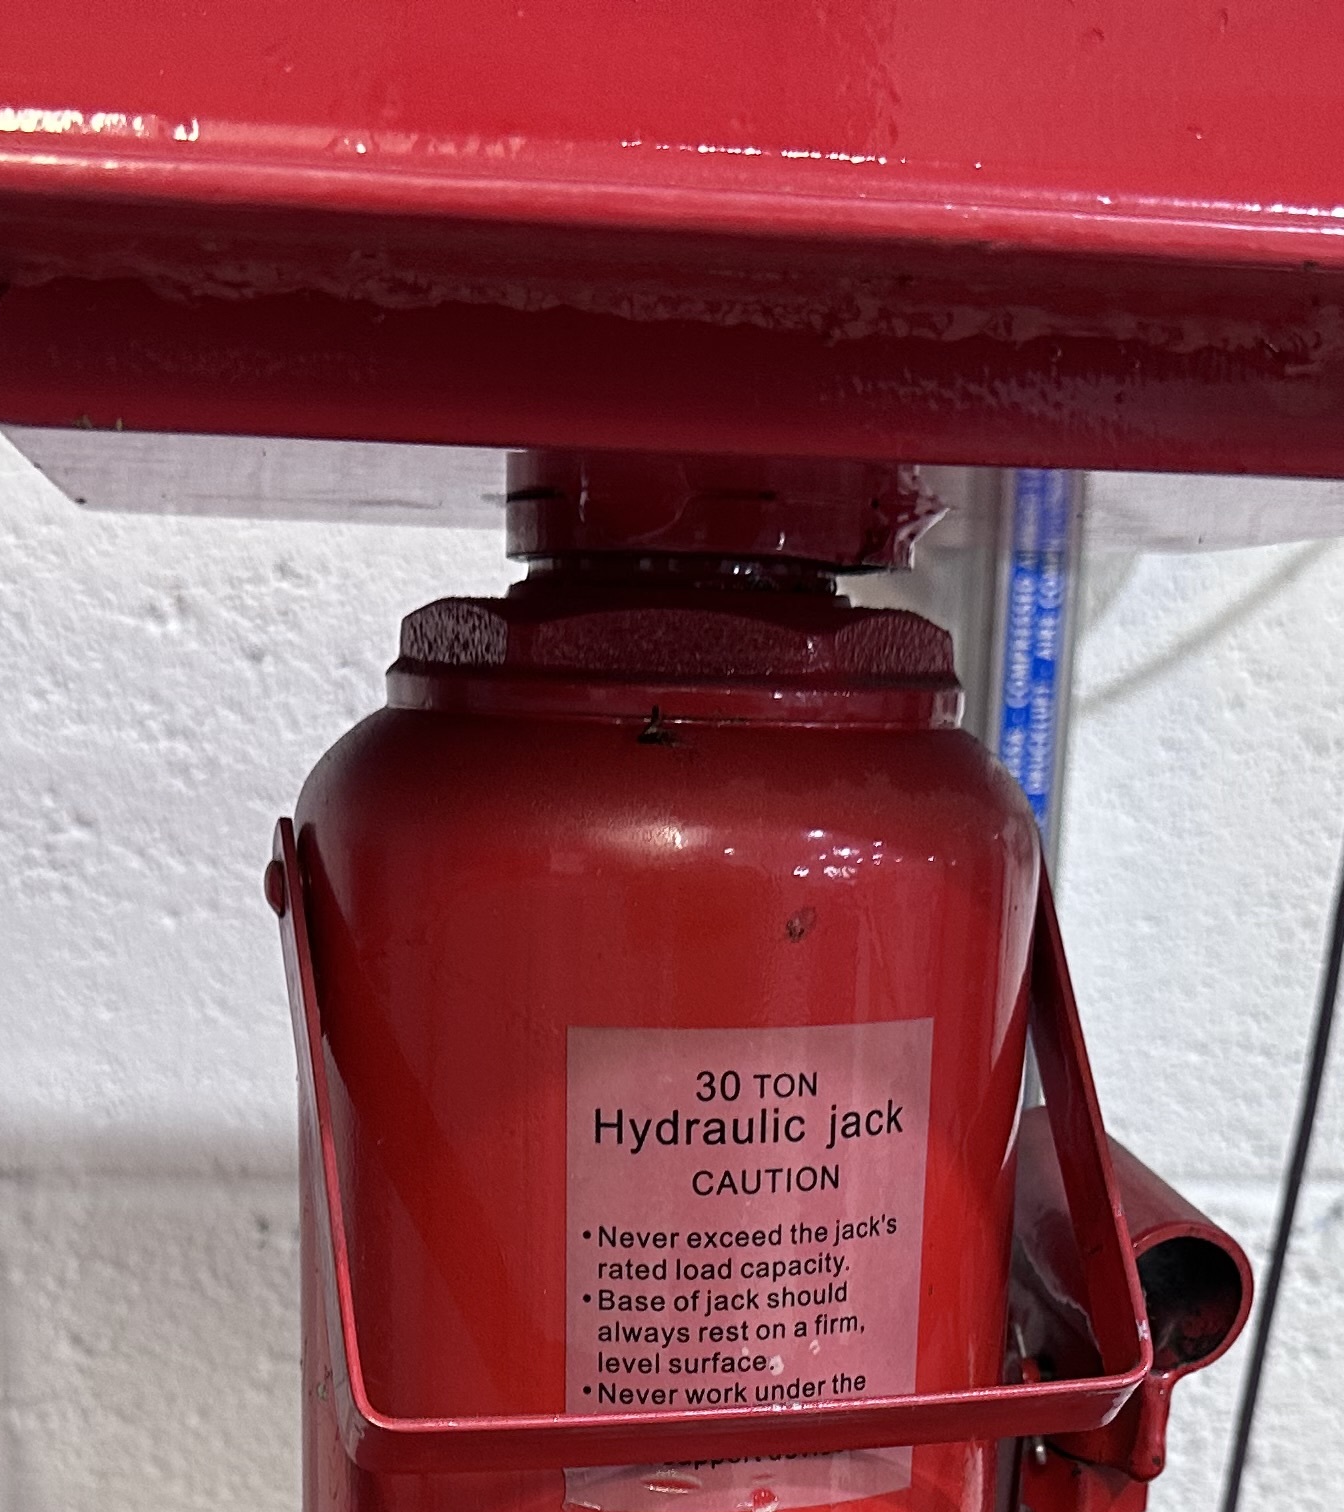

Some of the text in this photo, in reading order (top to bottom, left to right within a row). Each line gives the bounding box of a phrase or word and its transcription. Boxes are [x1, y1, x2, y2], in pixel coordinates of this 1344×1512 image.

[696, 1070, 818, 1102] 30 TON
[594, 1098, 904, 1155] Hydraulic jack
[692, 1164, 839, 1197] CAUTION
[598, 1214, 897, 1249] Never exceed the jack's
[598, 1252, 851, 1282] rated load capacity.
[598, 1281, 848, 1317] Base of jack should
[597, 1313, 866, 1349] always rest on a firm,
[598, 1351, 775, 1375] level surface.
[598, 1373, 866, 1405] Never work under the
